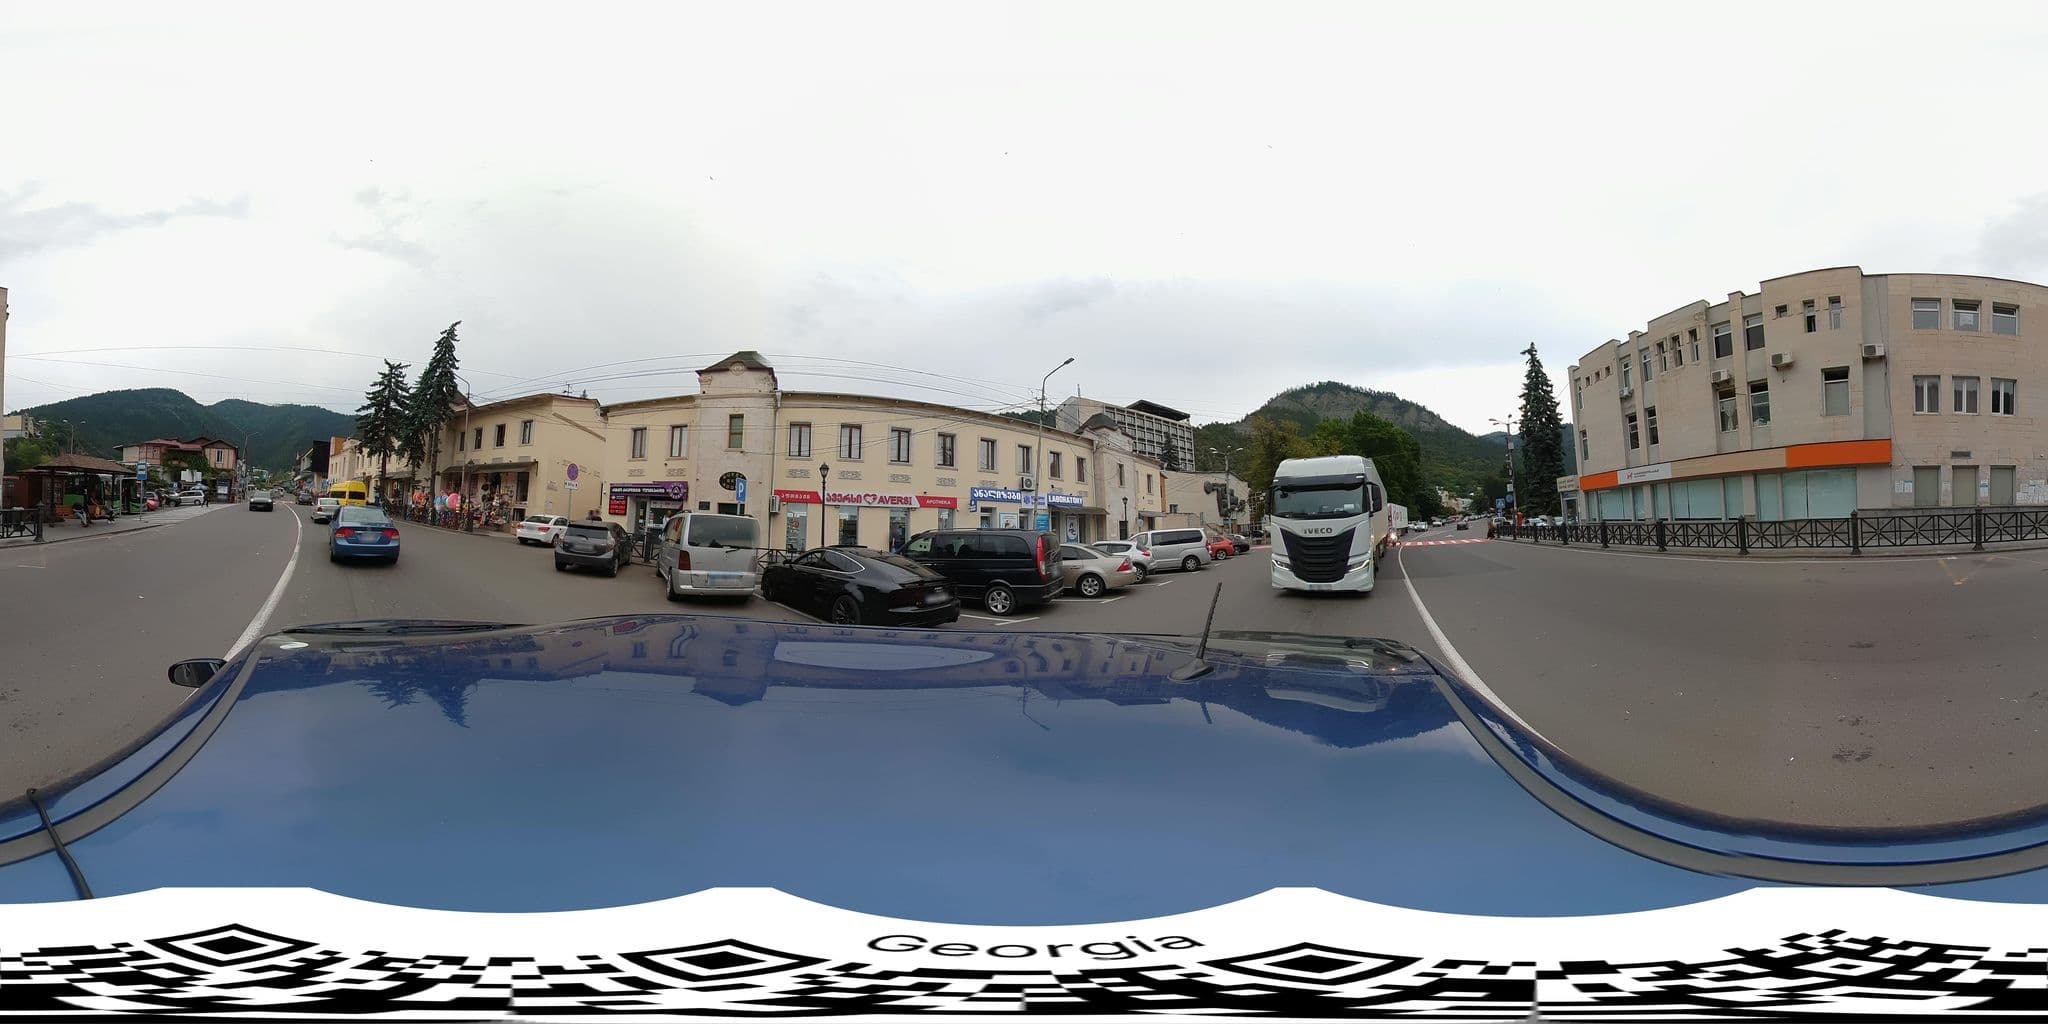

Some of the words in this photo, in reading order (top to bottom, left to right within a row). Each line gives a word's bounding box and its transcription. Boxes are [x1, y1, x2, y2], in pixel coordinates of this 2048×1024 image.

[738, 482, 744, 498] P
[973, 488, 1021, 501] ანალიზები
[826, 492, 862, 504] ავერსი
[878, 495, 913, 506] AVERSI
[1048, 495, 1083, 504] LABORATORY
[1303, 527, 1333, 535] IVECO
